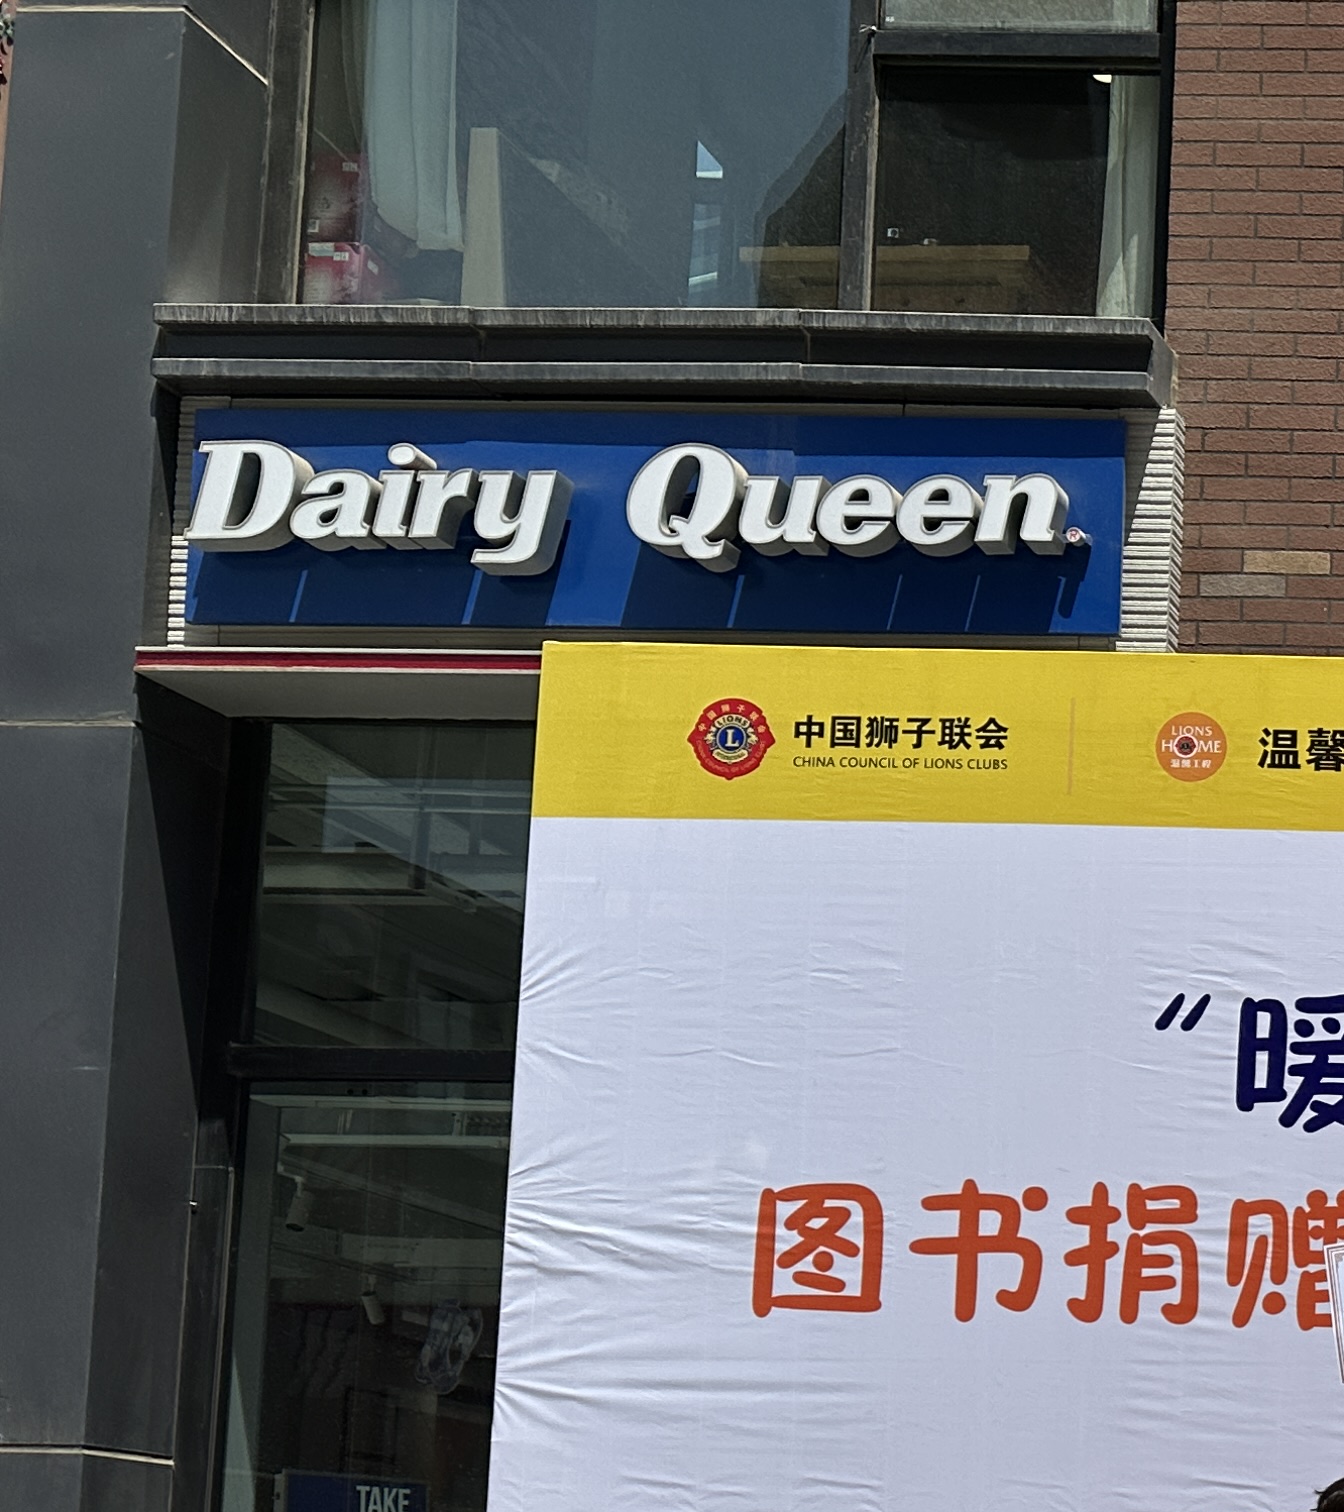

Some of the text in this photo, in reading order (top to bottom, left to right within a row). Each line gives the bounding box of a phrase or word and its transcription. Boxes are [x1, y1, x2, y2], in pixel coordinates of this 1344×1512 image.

[185, 439, 1068, 576] Dairy Queen
[793, 715, 1009, 750] 中国狮子联会
[1171, 725, 1213, 736] LIONS
[793, 756, 1008, 770] CHINA COUNCIL OF LIONS CLUBS
